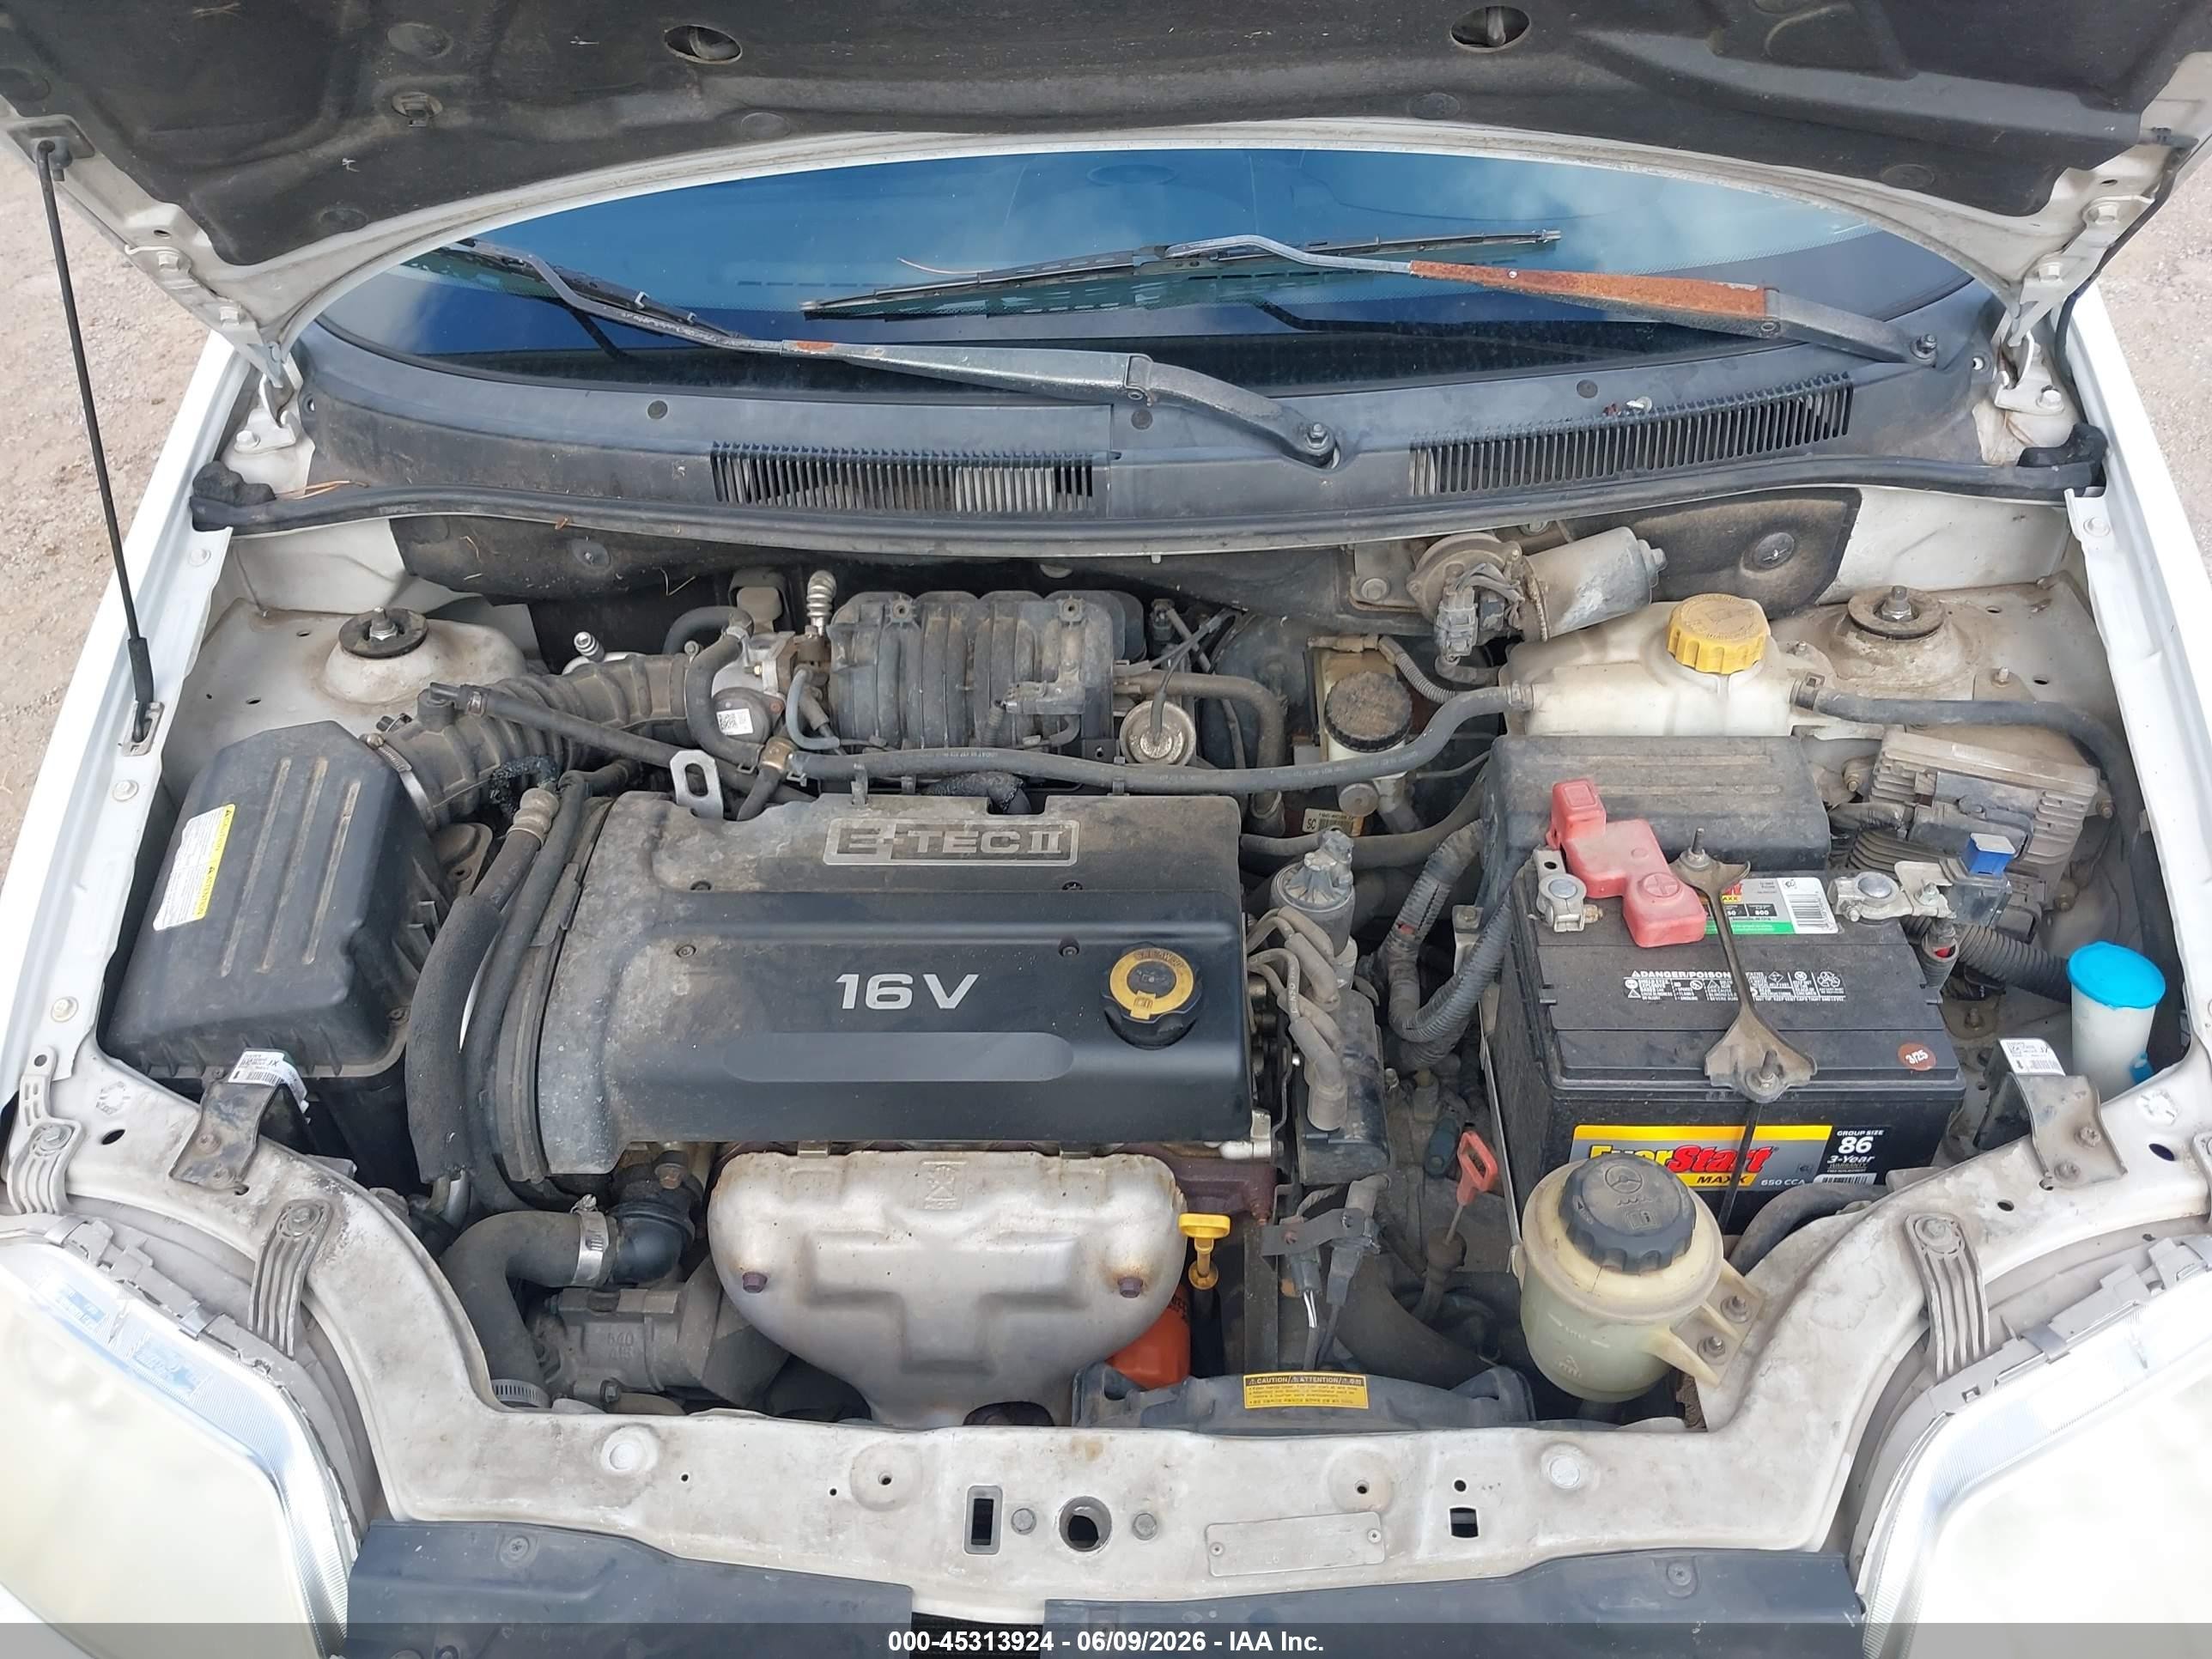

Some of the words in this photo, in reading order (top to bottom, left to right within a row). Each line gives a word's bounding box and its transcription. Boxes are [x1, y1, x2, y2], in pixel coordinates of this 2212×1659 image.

[1905, 1049, 1929, 1064] 3/25
[1838, 1136, 1874, 1154] 86
[1827, 1155, 1875, 1164] 3-Year
